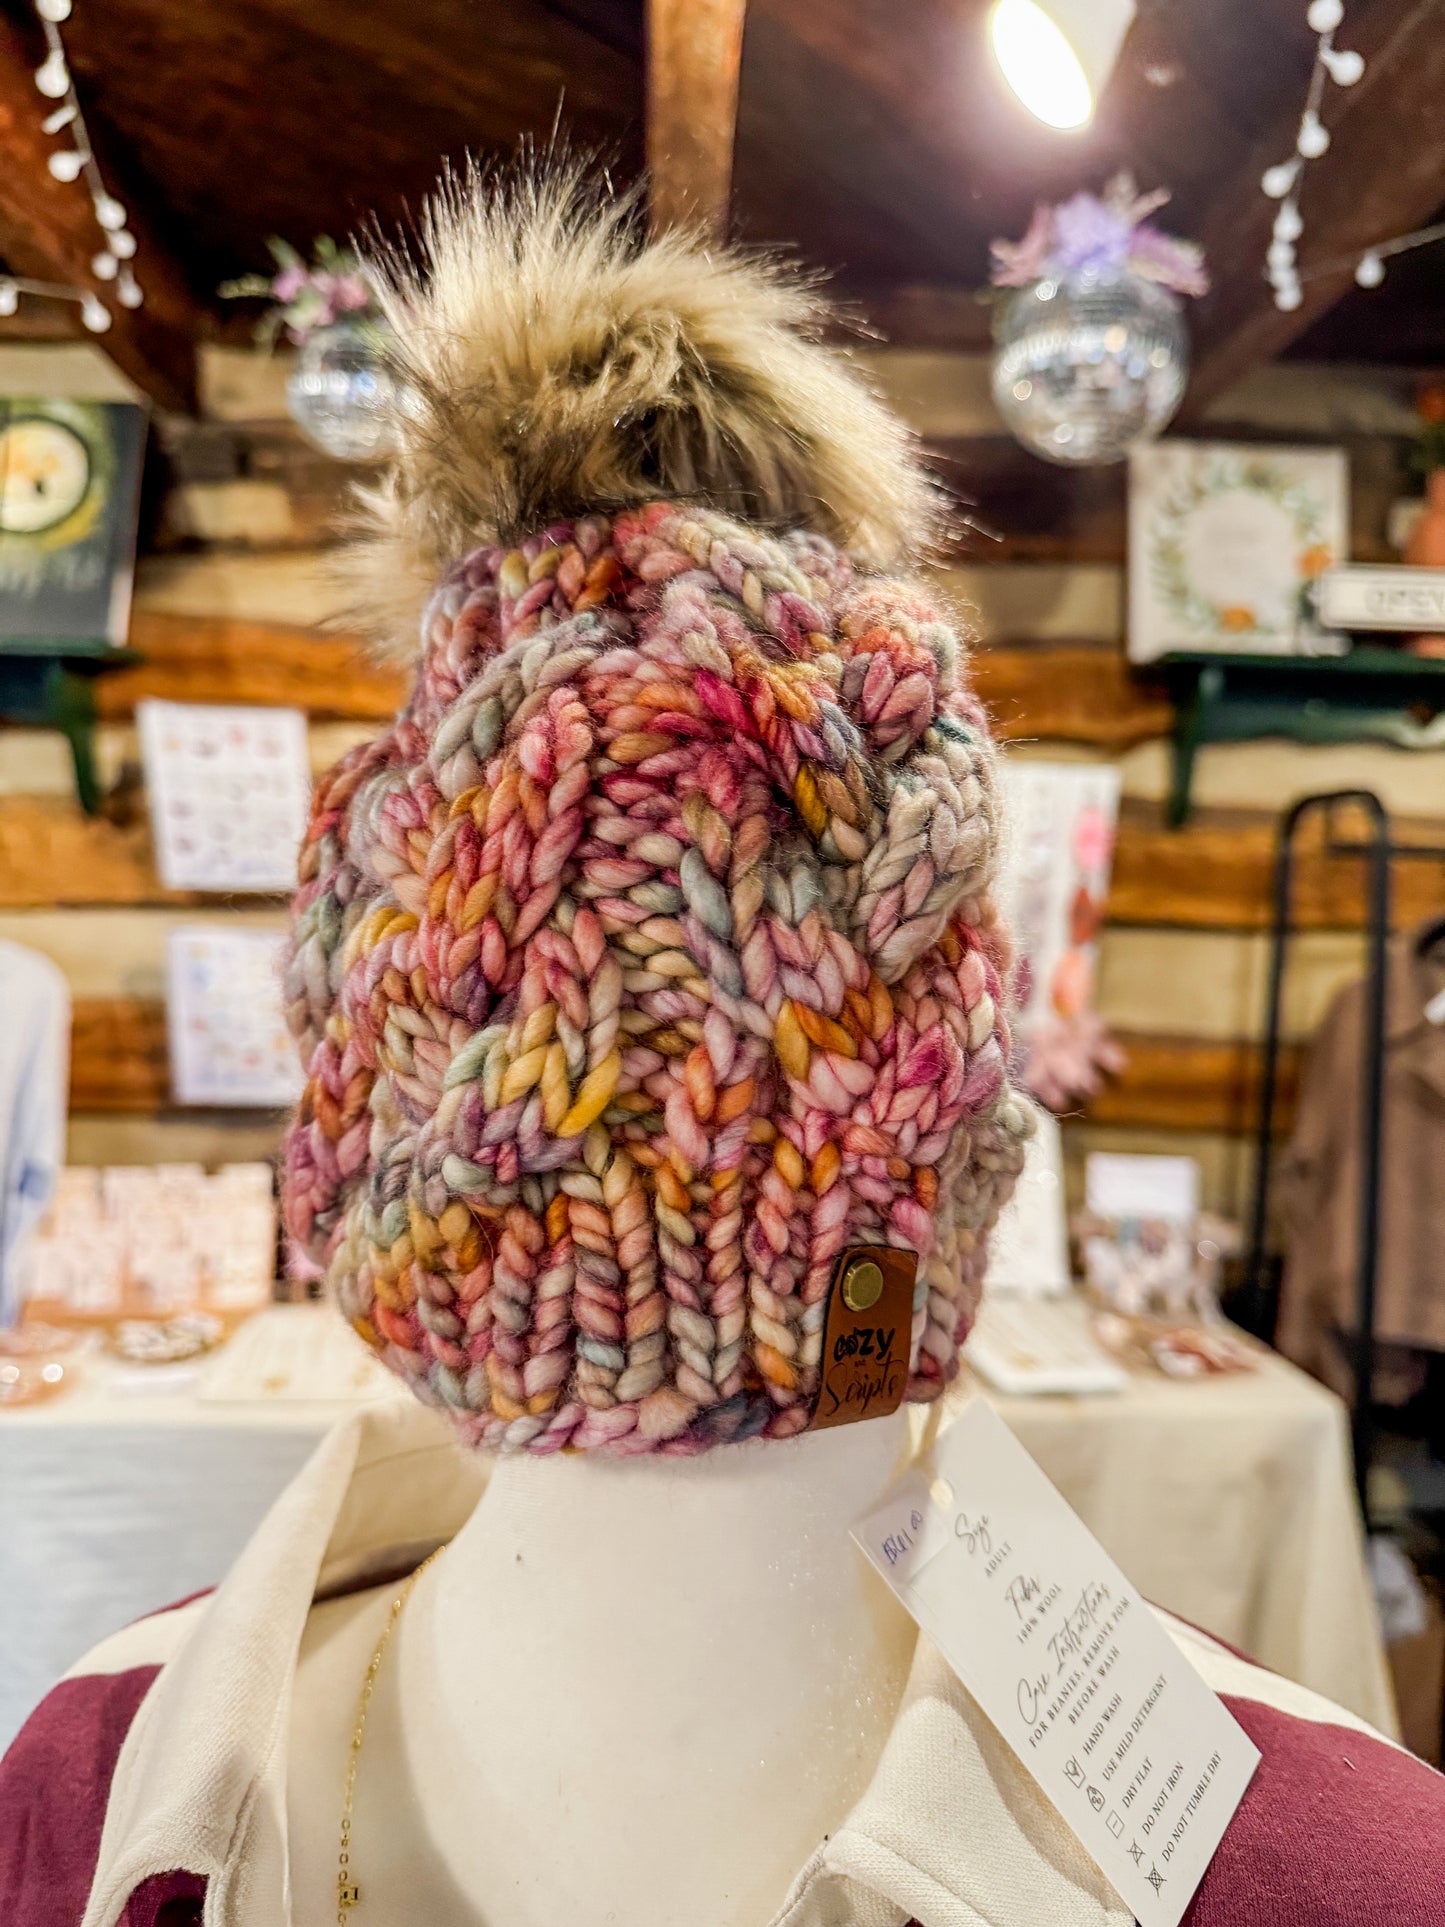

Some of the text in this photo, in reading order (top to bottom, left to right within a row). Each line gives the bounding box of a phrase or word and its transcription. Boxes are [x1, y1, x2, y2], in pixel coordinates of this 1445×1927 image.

[955, 1512, 991, 1554] Size
[984, 1541, 1013, 1577] ADULT
[1017, 1583, 1063, 1644] 100% WOOL
[1017, 1581, 1111, 1725] Care Instructions
[1028, 1596, 1130, 1749] FOR BEANIES, REMOVE POM
[1067, 1645, 1120, 1725] BEFORE WASH
[1082, 1693, 1123, 1755] HAND WASH
[1102, 1674, 1167, 1781] USE MILD DETERGENT
[1122, 1756, 1153, 1808] DRY FLAT
[1142, 1761, 1184, 1835] DO NOT IRON
[1161, 1750, 1222, 1862] DO NOT TUMBLE DRY
